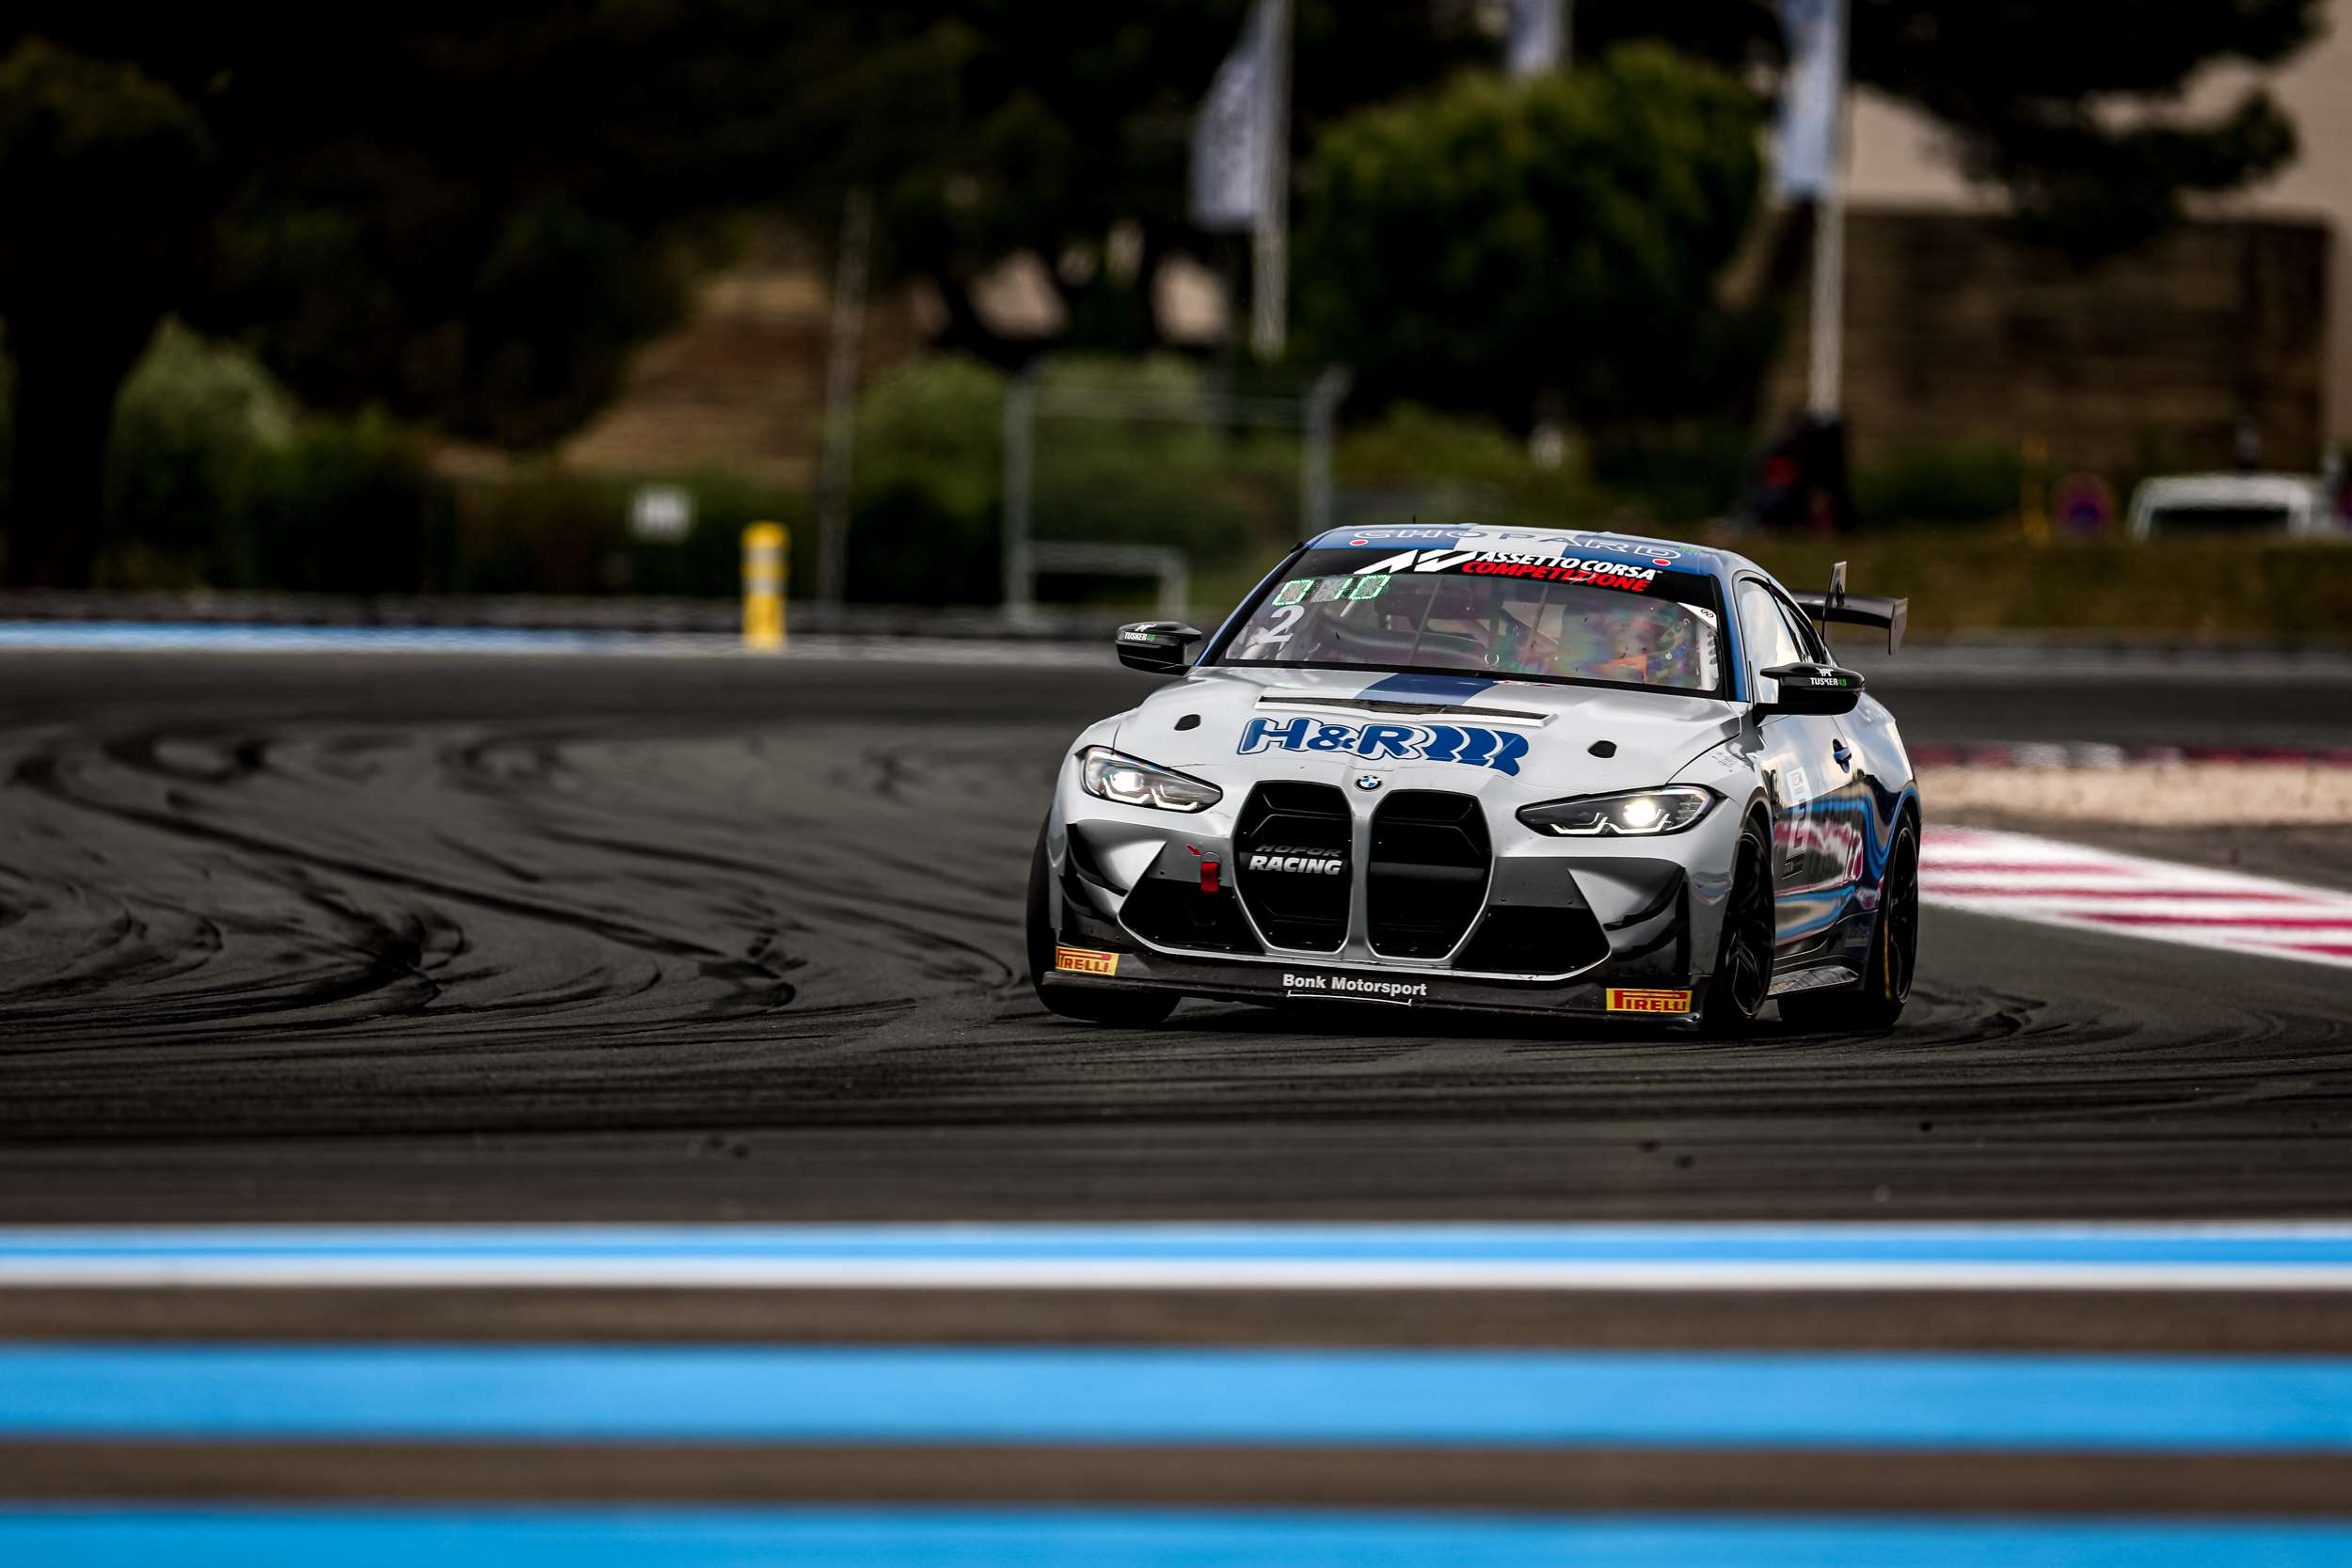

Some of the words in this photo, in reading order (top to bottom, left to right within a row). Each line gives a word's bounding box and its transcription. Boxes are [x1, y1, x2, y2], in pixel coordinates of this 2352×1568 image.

[1461, 561, 1652, 592] COMPETIZIONE
[1475, 551, 1581, 569] ASSETTO
[1581, 560, 1659, 581] CORSA
[1262, 605, 1306, 643] 2
[1237, 717, 1430, 761] H&R
[1255, 845, 1343, 858] HOFOR
[1248, 855, 1343, 876] RACING
[1282, 974, 1327, 989] Bonk
[1331, 976, 1427, 997] Motorsport
[1613, 990, 1688, 1011] PIRELLI
